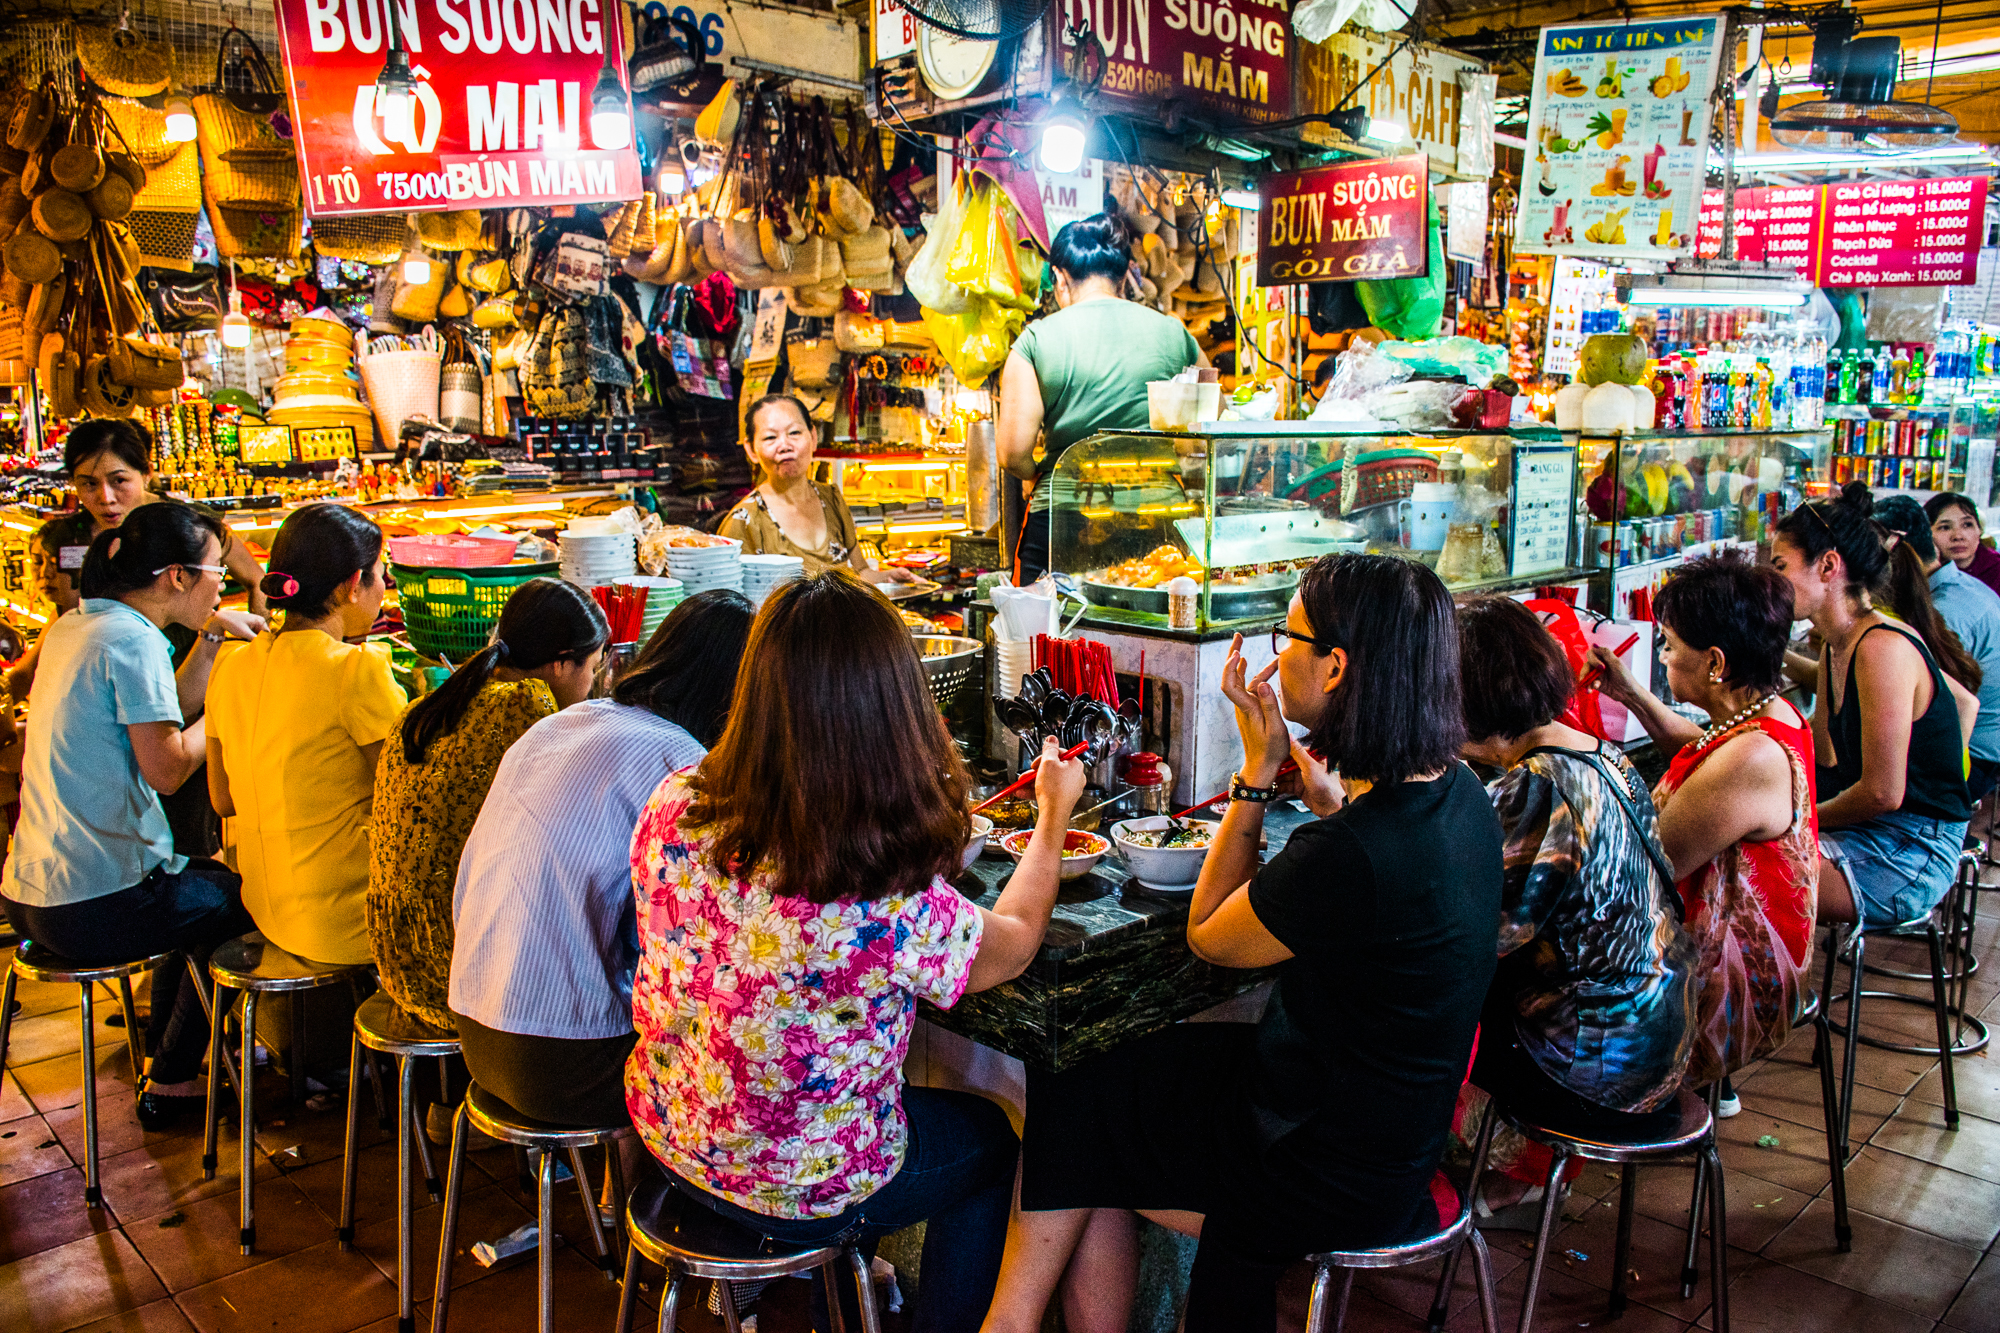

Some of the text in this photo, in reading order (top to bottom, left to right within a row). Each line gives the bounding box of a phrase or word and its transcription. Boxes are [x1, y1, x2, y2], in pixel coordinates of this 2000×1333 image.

[1164, 0, 1285, 58] SUÔNG
[1182, 47, 1268, 104] MẮM
[466, 79, 580, 151] MAI
[312, 174, 327, 204] 1
[328, 167, 360, 204] TÔ
[446, 154, 520, 201] BÚN
[1269, 172, 1417, 247] BÚN SUÔNG
[1331, 204, 1392, 242] MẮM
[1270, 249, 1335, 278] GỎI
[1830, 254, 1879, 267] Cocktail
